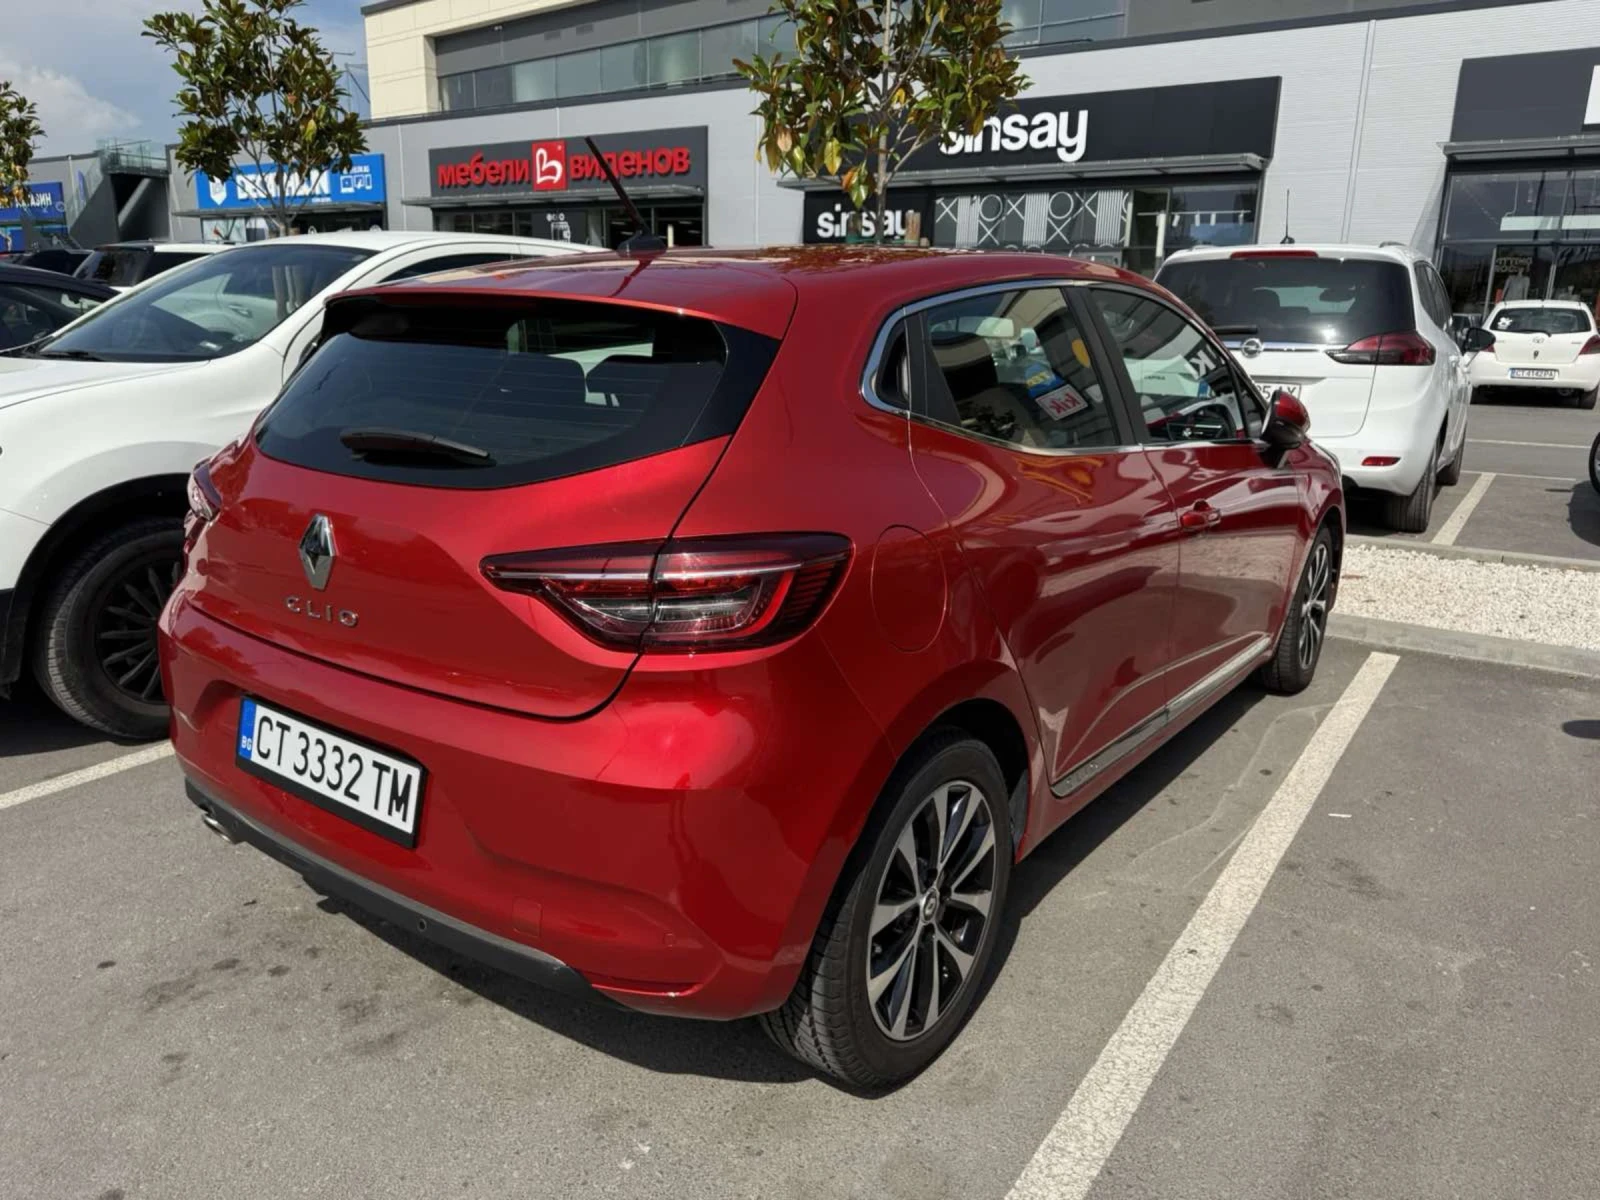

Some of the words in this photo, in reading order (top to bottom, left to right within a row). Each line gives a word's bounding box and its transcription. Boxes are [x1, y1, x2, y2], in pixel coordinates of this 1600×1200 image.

[437, 153, 531, 187] мебели
[569, 147, 690, 180] виденов
[284, 595, 360, 627] CLIO
[256, 715, 291, 767] CT
[293, 731, 364, 803] 3332
[372, 760, 413, 823] TM
